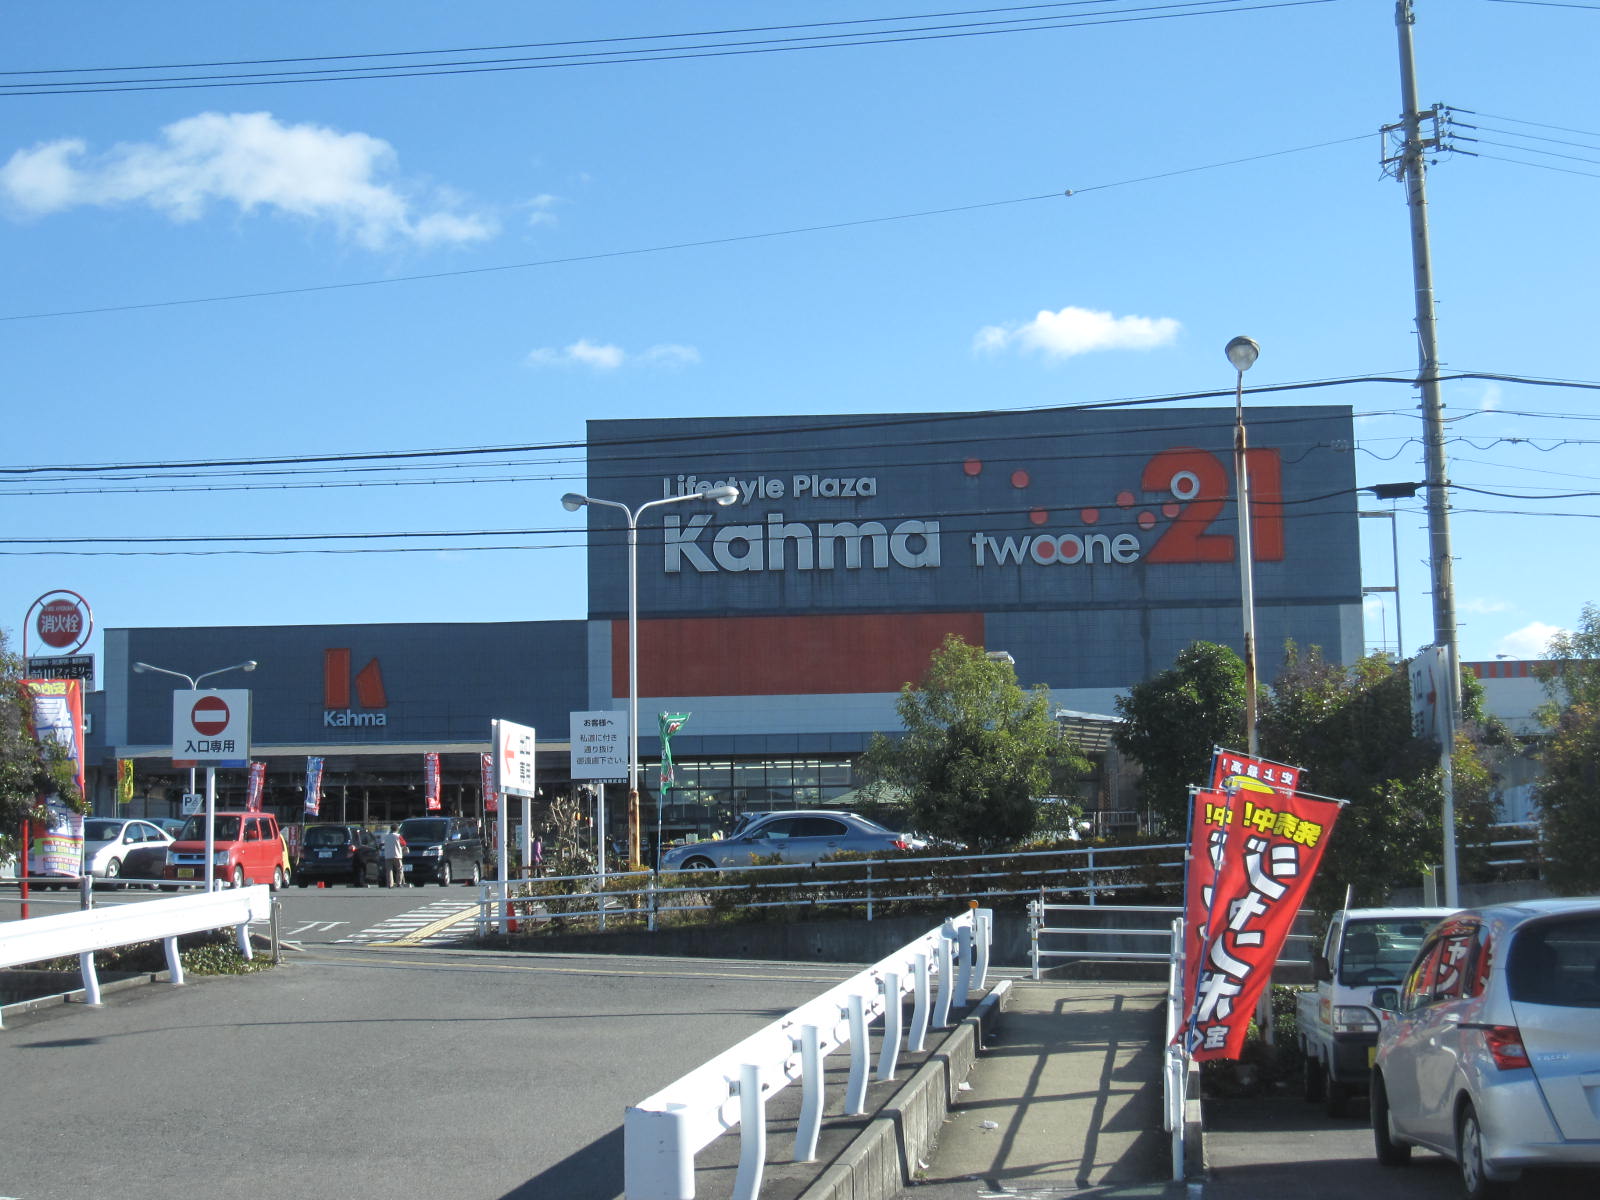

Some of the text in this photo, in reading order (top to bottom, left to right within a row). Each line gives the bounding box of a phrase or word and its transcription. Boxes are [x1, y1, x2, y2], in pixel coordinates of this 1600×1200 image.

[793, 474, 877, 498] Plaza
[971, 446, 1285, 567] twoone 21
[663, 512, 941, 573] Kahma
[41, 613, 80, 633] 消火栓
[56, 665, 92, 674] ファミリー
[323, 709, 387, 727] Kahma
[583, 718, 614, 727] お客様へ
[580, 734, 617, 743] 私道に付き
[184, 739, 235, 753] 入口専用
[583, 745, 614, 754] 通り抜け
[184, 796, 193, 807] P
